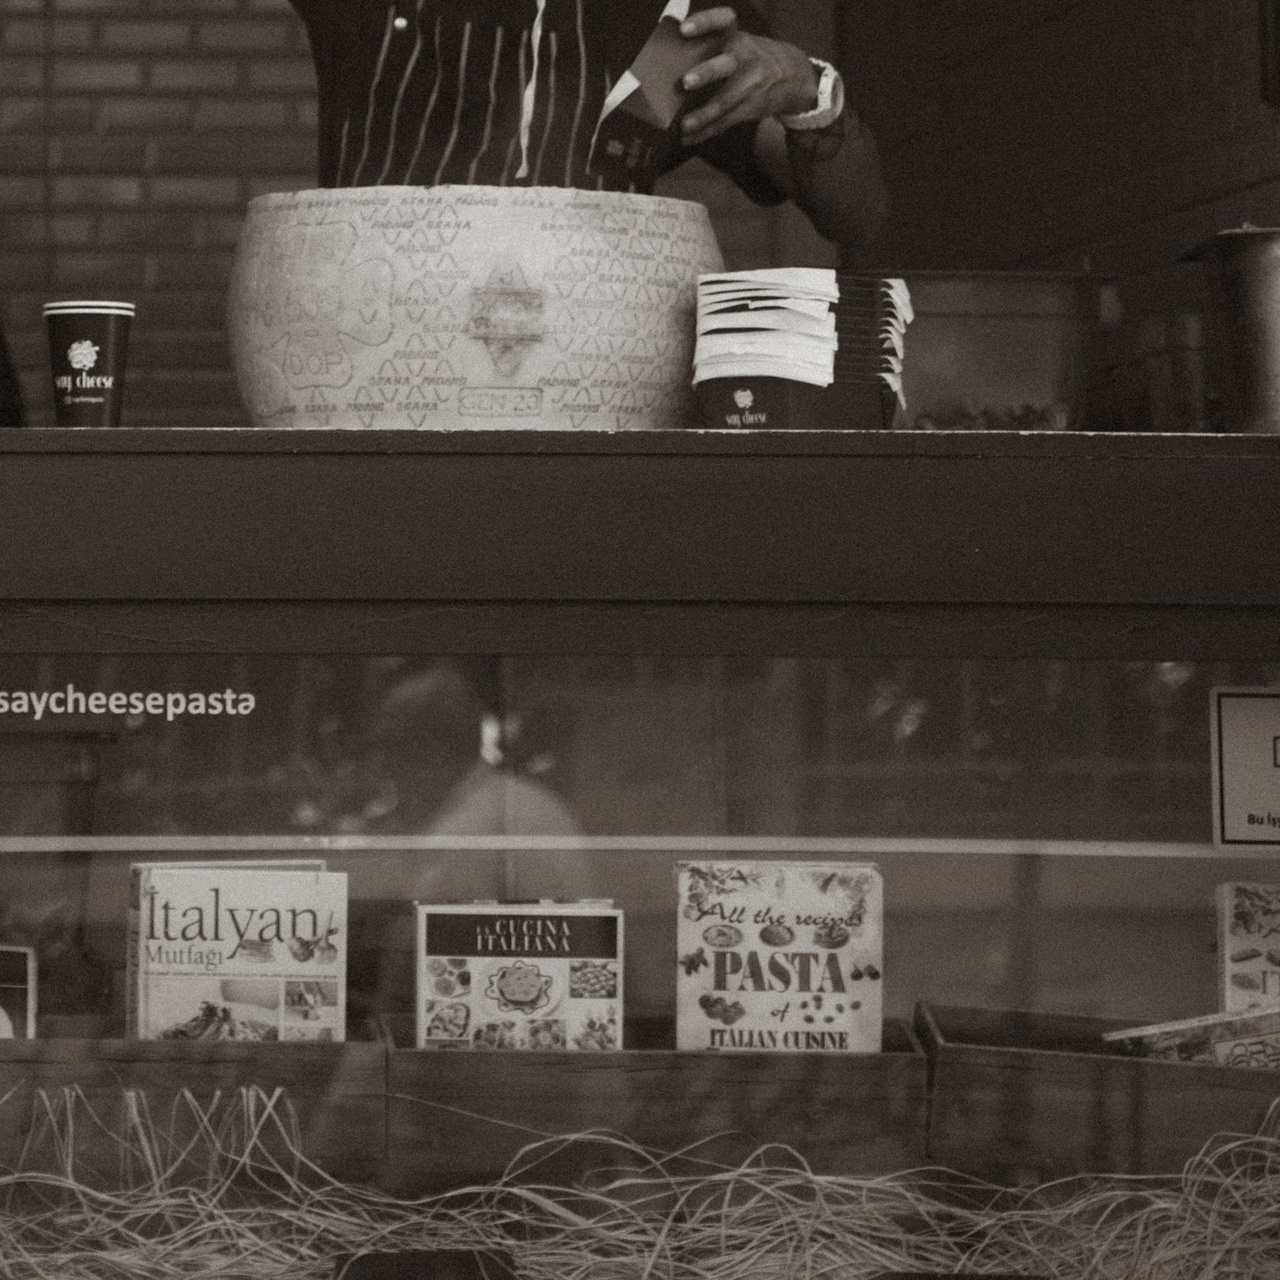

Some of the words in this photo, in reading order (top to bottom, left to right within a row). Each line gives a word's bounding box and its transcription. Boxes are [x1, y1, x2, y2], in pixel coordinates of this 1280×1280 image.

[1247, 813, 1264, 825] Bu
[697, 902, 746, 925] All
[752, 906, 786, 927] the
[494, 918, 571, 936] CUCINA
[475, 934, 571, 952] ITALIANA
[711, 950, 847, 994] PASTA
[770, 1002, 791, 1023] of
[709, 1028, 779, 1049] ITALIAN
[782, 1030, 850, 1051] CUISINE
